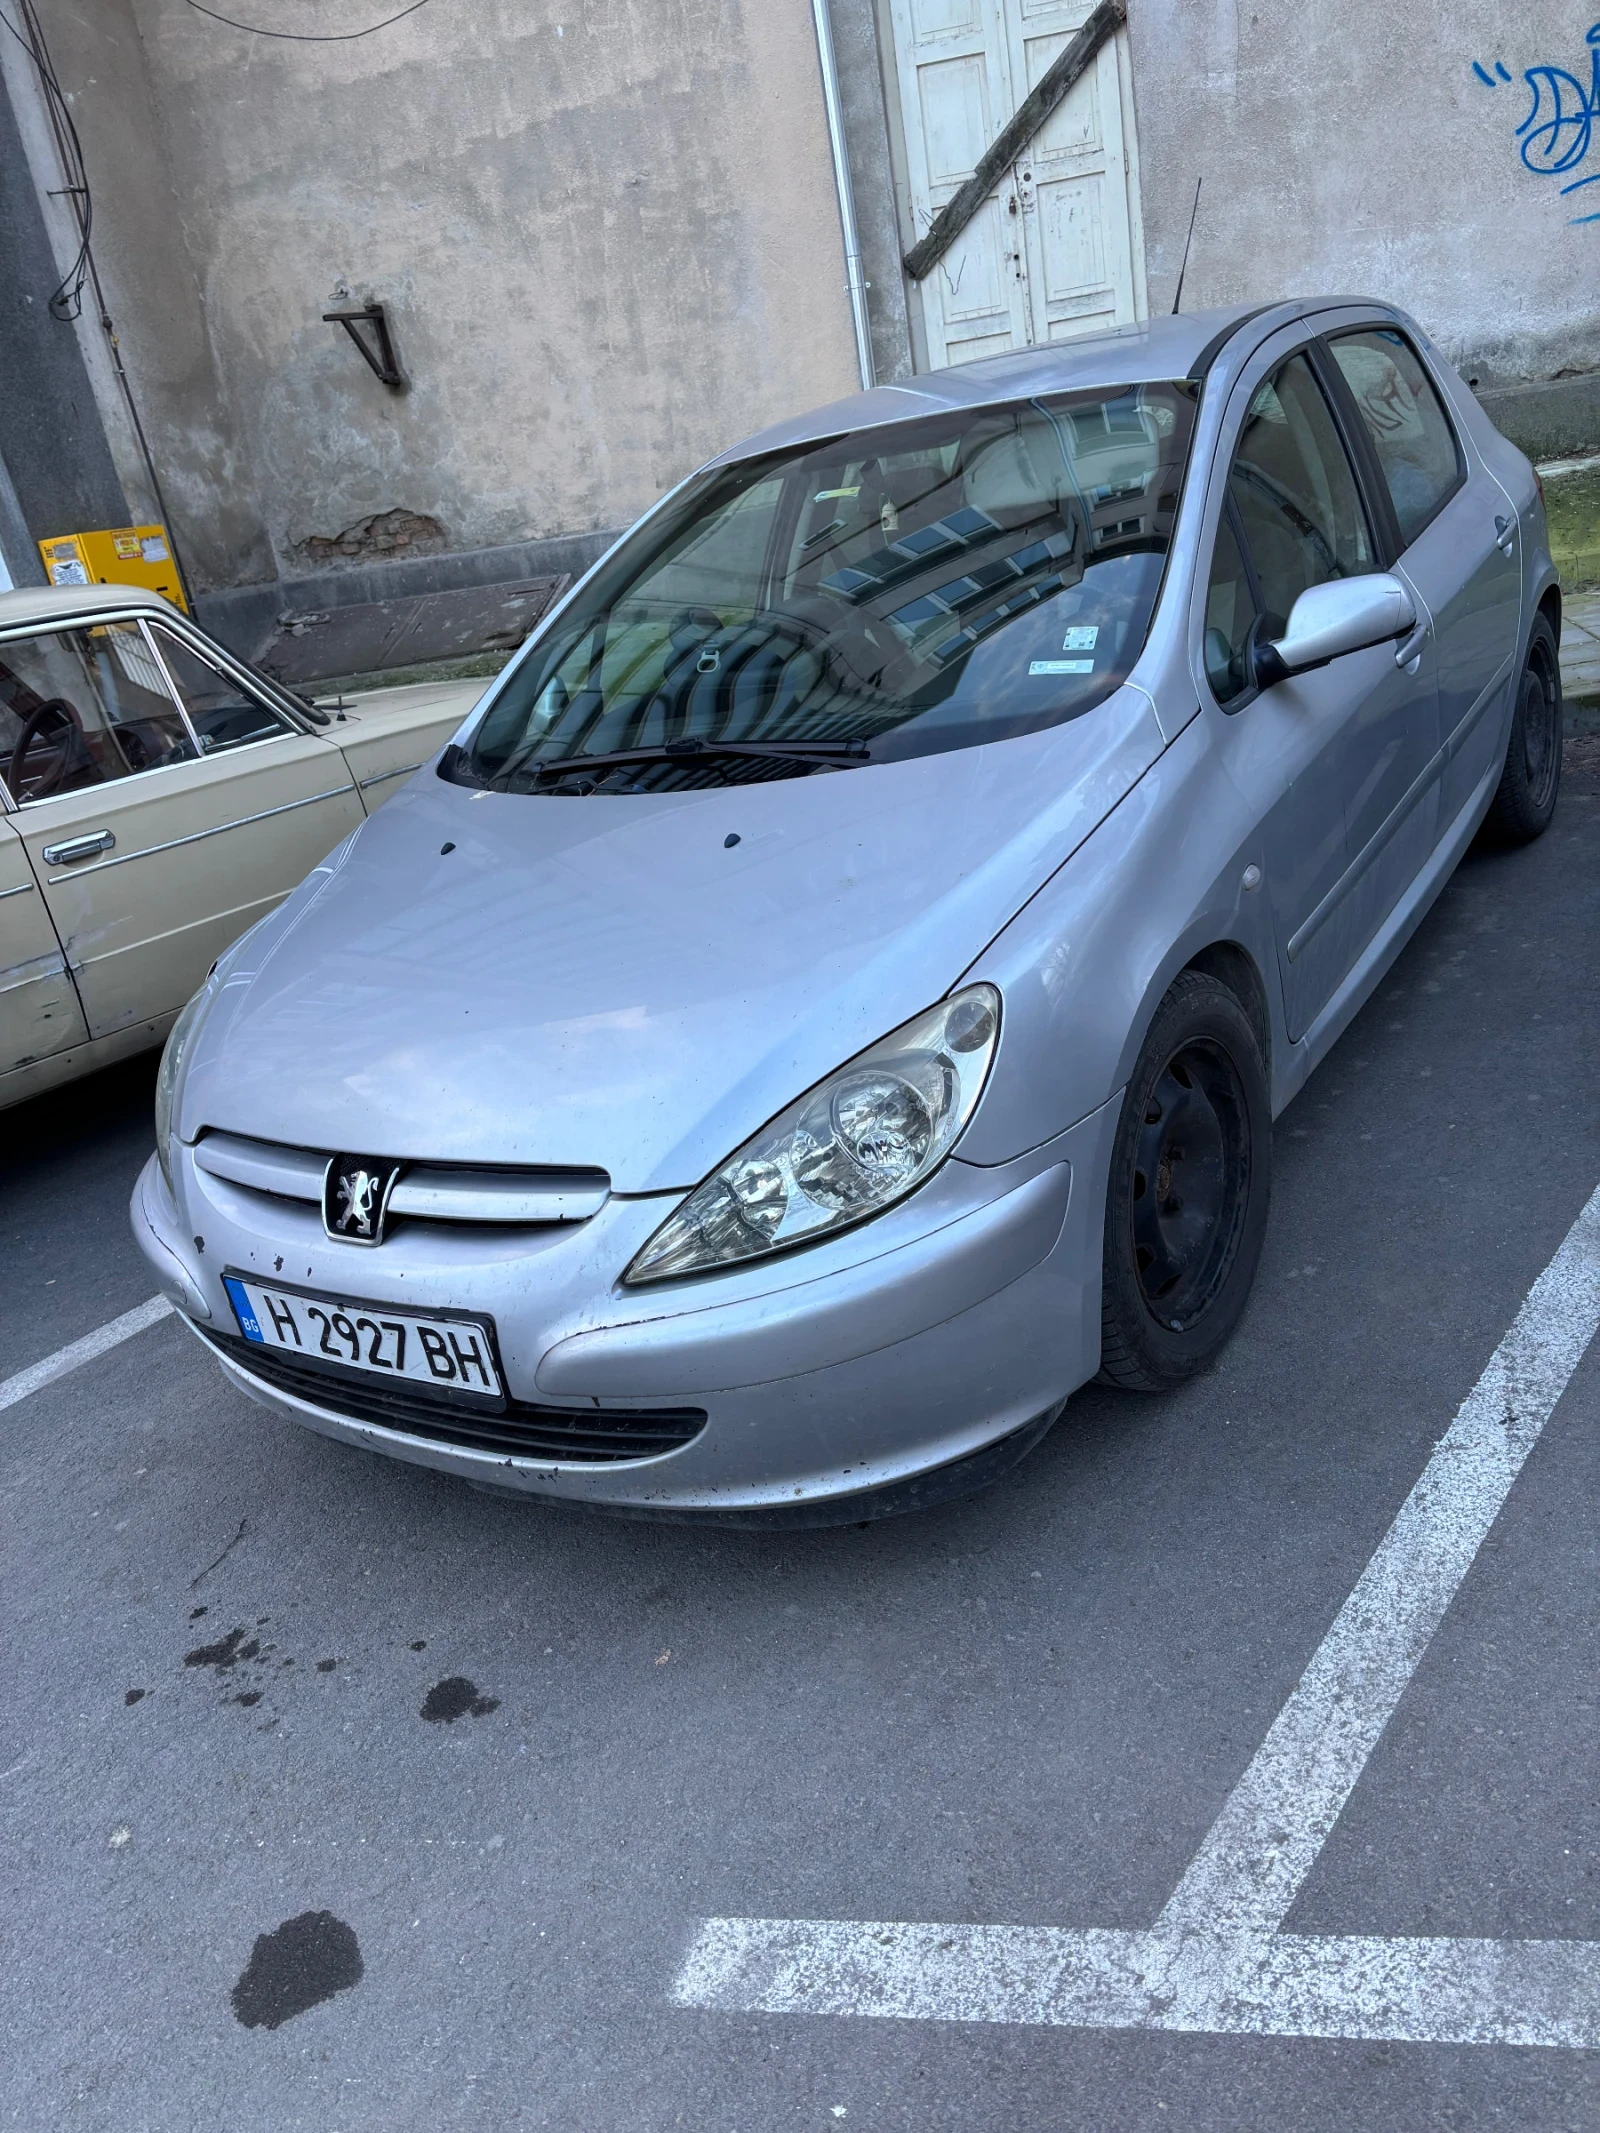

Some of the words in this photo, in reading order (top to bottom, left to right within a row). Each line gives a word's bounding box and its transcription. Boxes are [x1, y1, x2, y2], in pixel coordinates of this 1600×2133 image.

[242, 1316, 259, 1333] BG
[263, 1295, 302, 1346] H
[308, 1307, 406, 1370] 2927
[417, 1326, 491, 1387] BH
